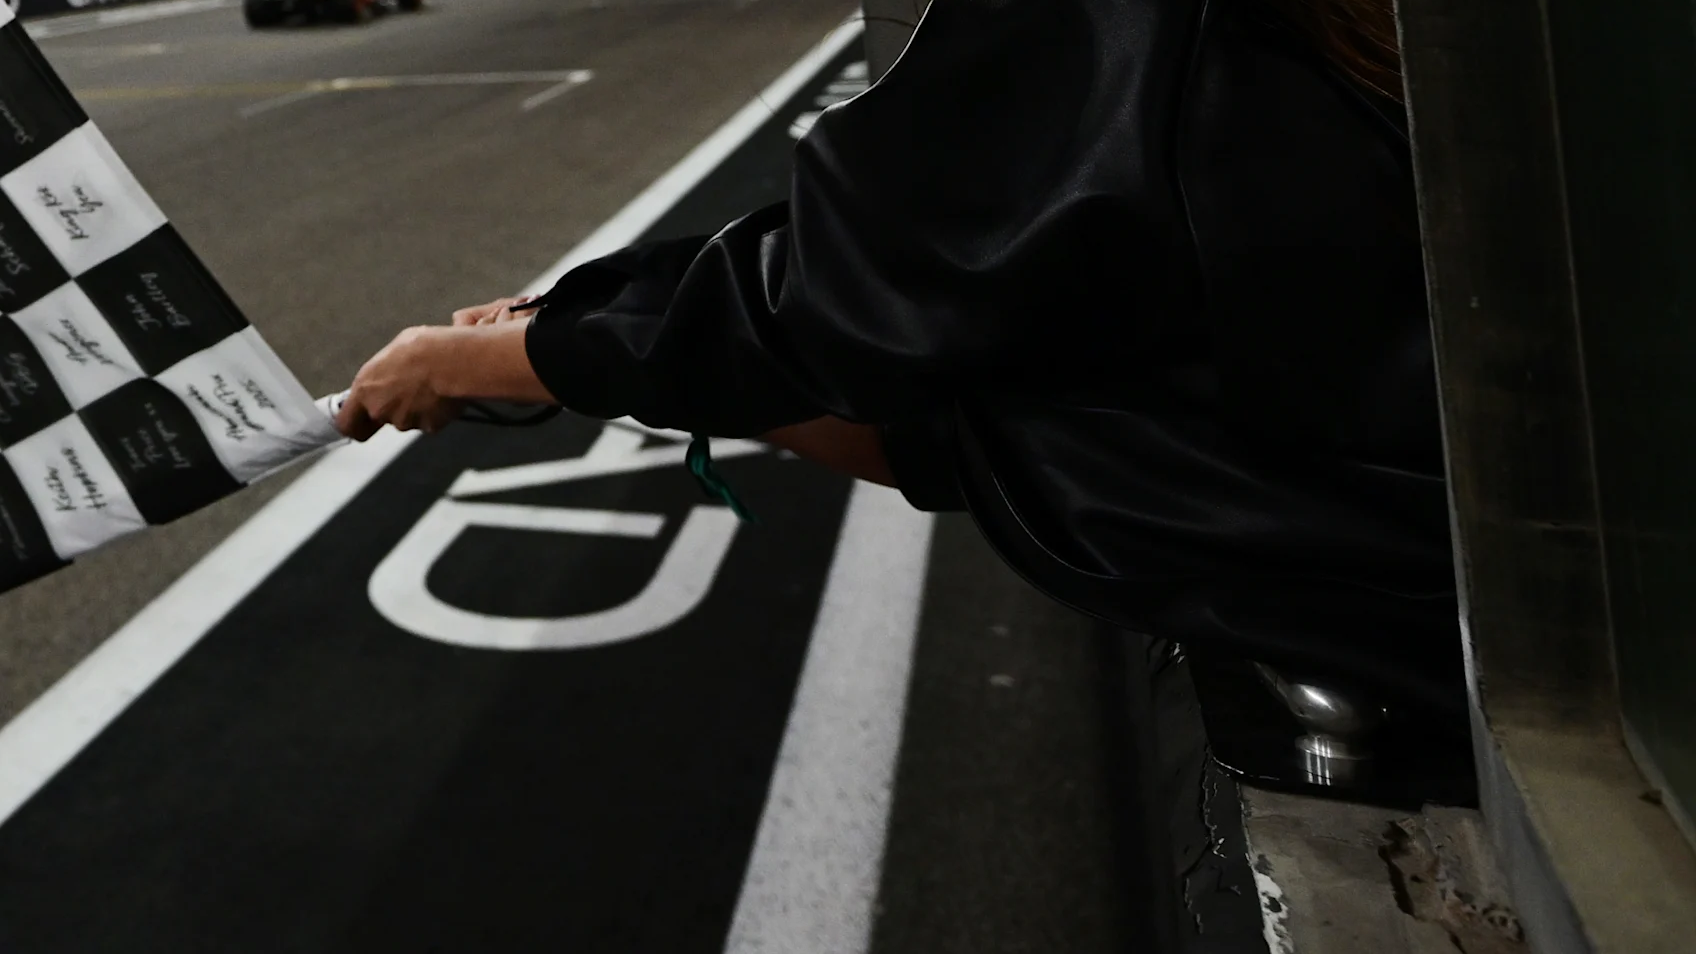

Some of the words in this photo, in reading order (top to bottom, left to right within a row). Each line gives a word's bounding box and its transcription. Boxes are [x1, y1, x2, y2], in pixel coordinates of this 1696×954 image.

[124, 293, 162, 330] John
[43, 465, 78, 512] Keith
[60, 446, 108, 511] Hopkins
